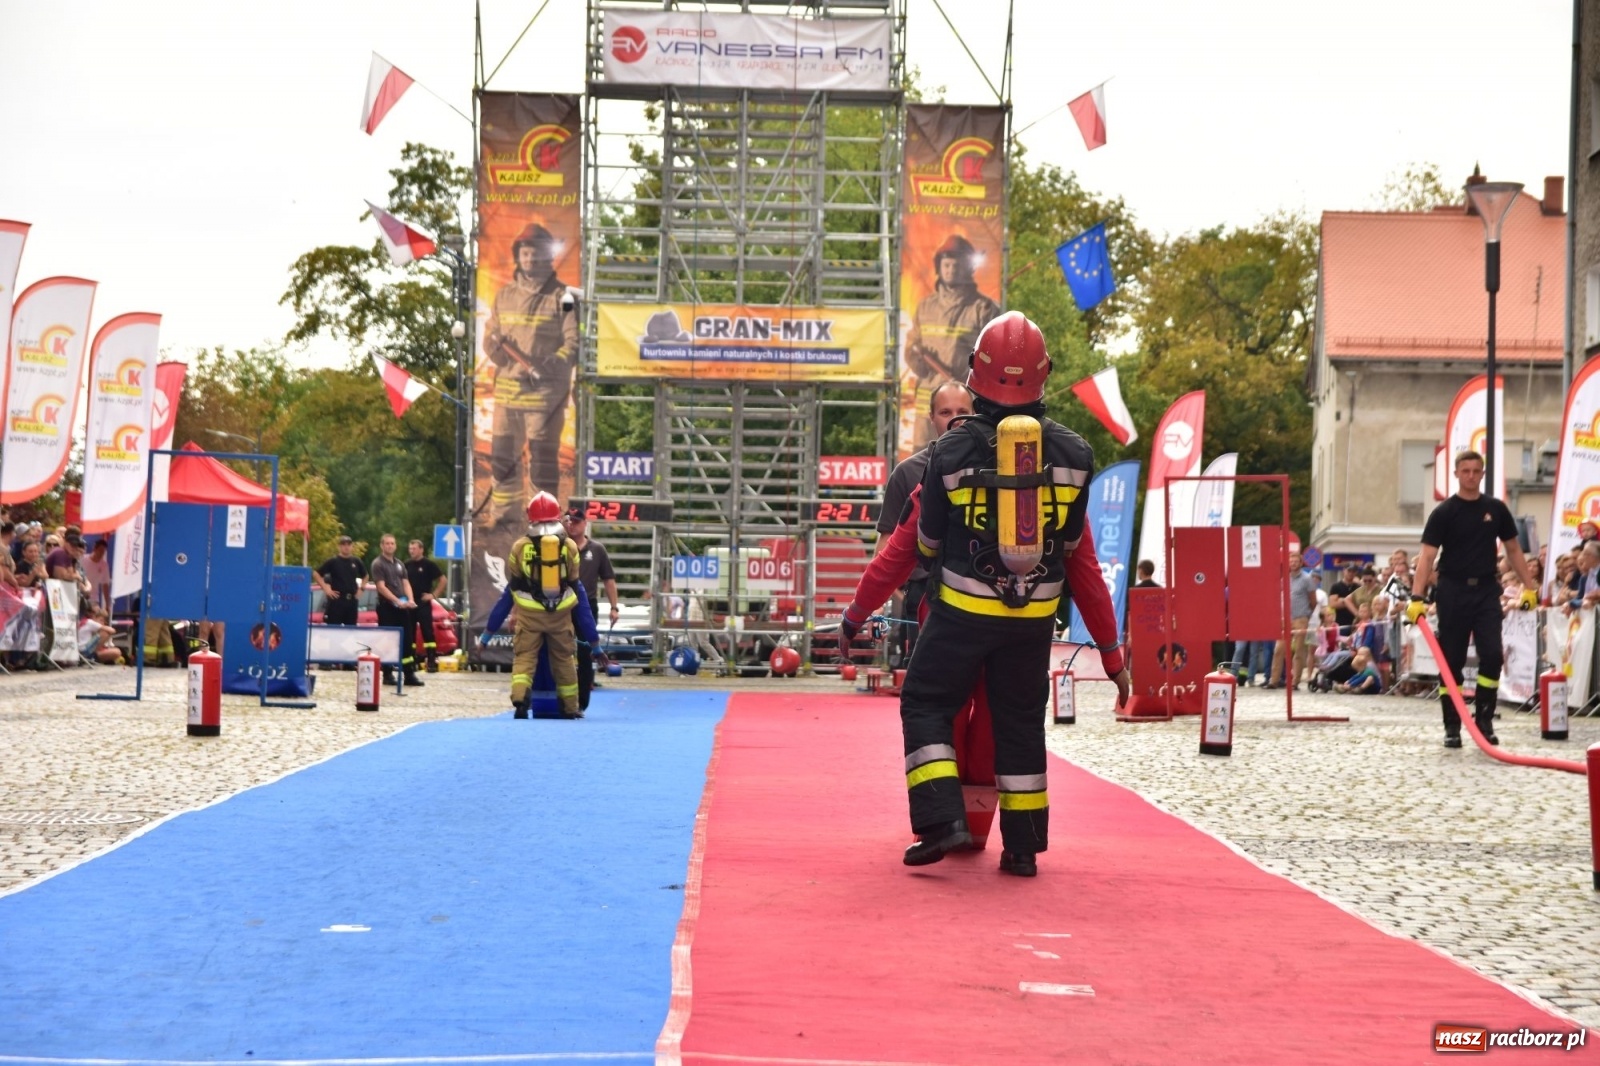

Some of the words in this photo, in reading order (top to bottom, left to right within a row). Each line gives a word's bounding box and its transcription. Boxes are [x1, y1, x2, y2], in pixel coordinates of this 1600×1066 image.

[656, 28, 717, 38] RADIO
[657, 41, 823, 59] VANESSA
[835, 47, 883, 60] FM
[500, 173, 541, 183] KALISZ
[922, 184, 964, 194] KALISZ
[486, 192, 577, 206] www.kzpt.pl
[909, 203, 999, 218] www.kzpt.pl
[695, 317, 833, 340] GRAN-MIX
[644, 348, 686, 357] hurtownia
[688, 348, 722, 358] kamieni
[723, 349, 773, 360] naturalnych
[780, 350, 805, 359] kostki
[807, 352, 846, 362] brukowej
[587, 456, 654, 476] START
[819, 462, 884, 480] START
[131, 512, 143, 576] VANE
